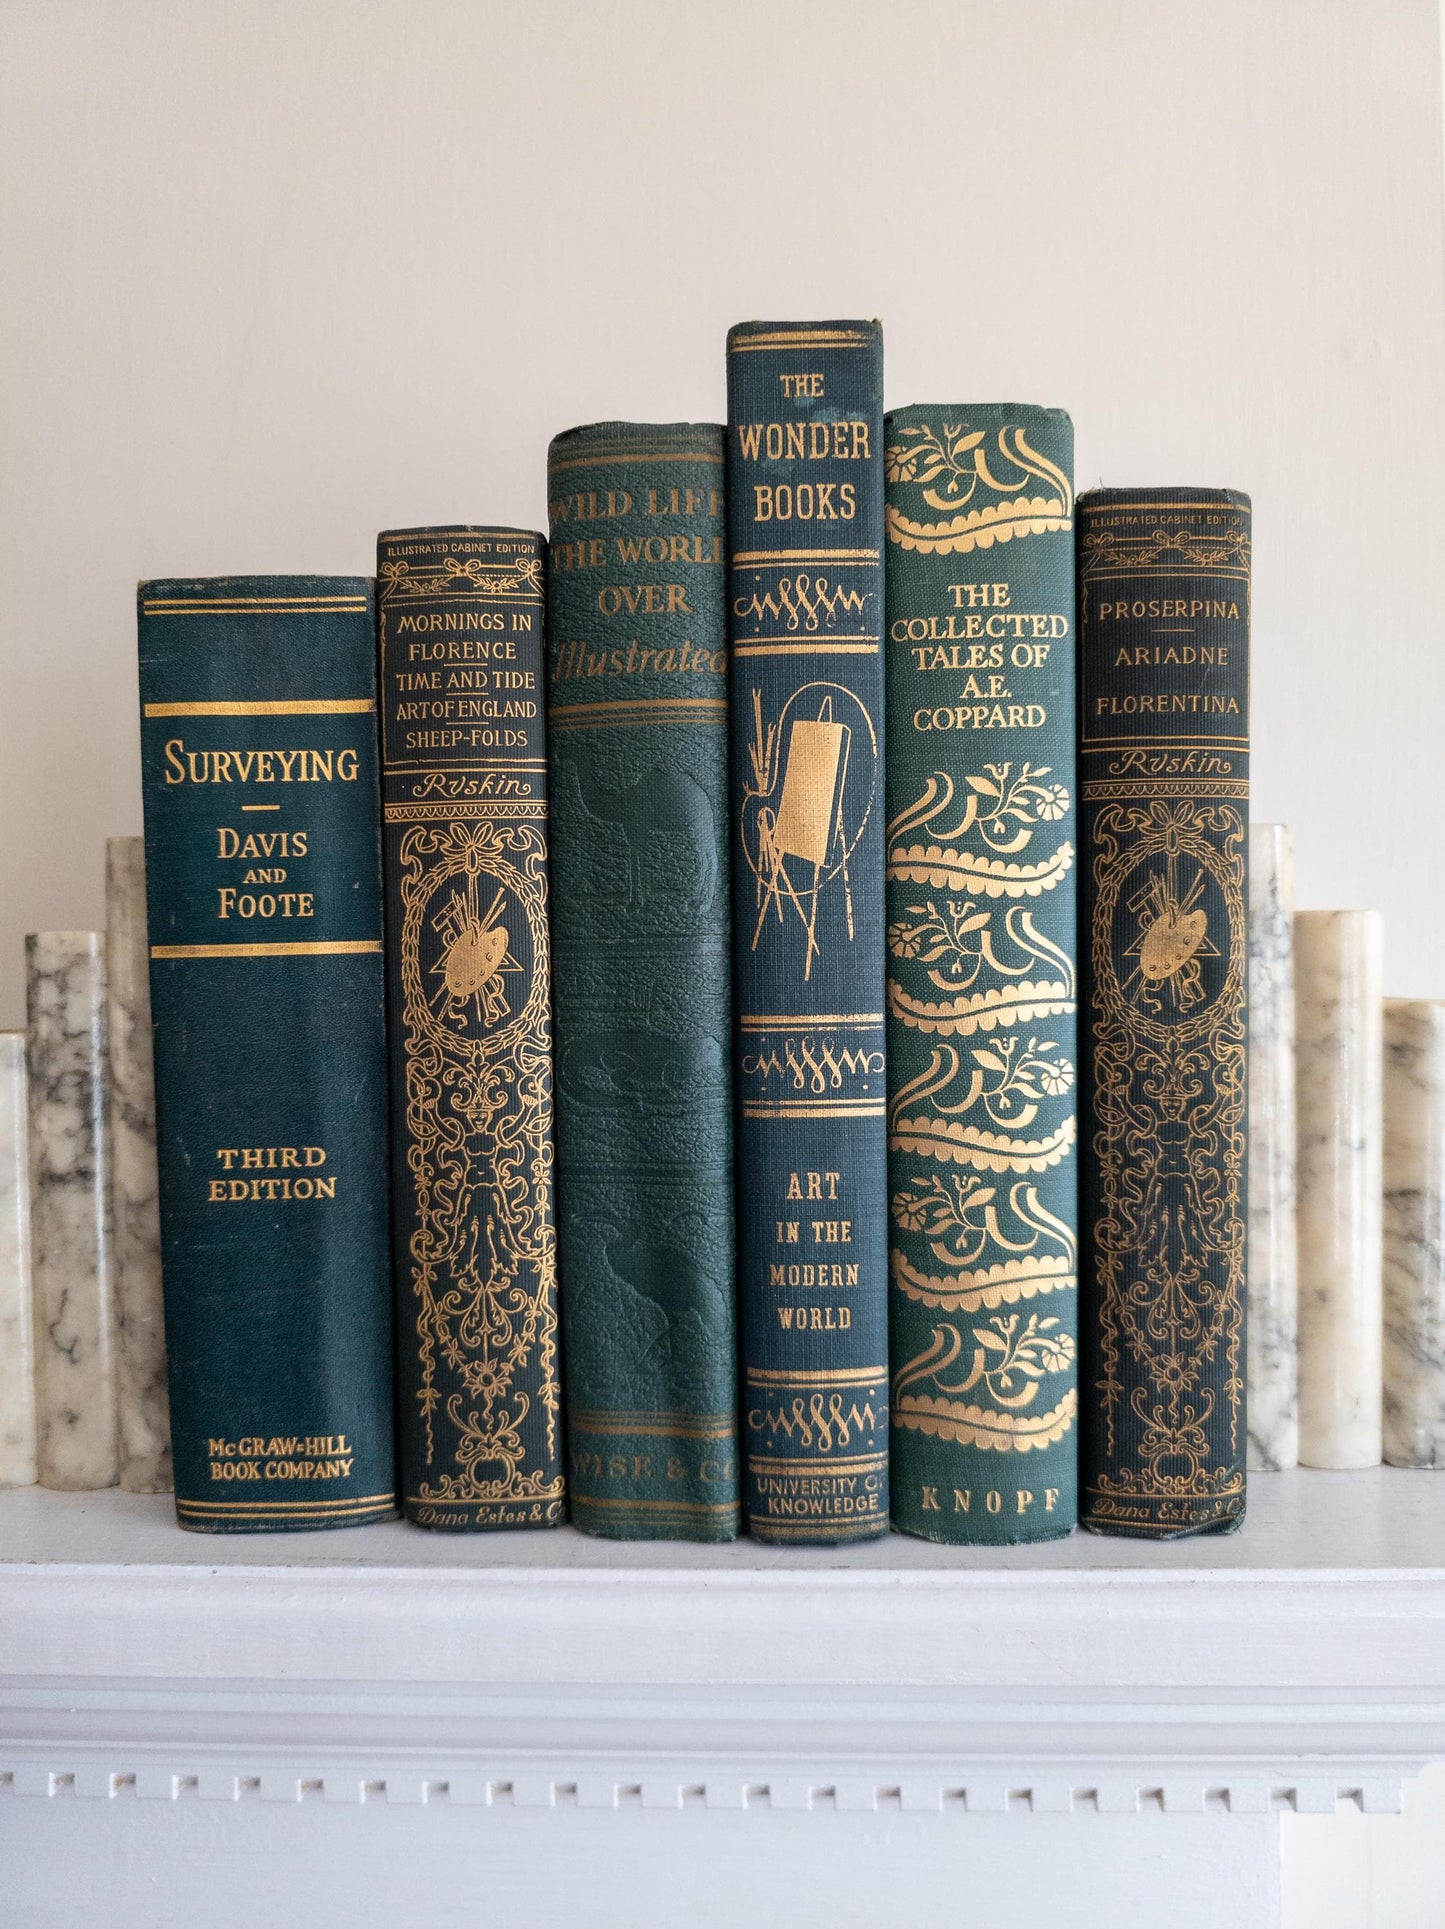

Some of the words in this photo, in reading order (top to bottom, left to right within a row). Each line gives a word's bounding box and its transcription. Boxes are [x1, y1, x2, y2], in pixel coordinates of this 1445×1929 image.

[779, 372, 825, 398] THE
[738, 420, 872, 461] WONDER
[753, 483, 856, 522] BOOKS
[386, 542, 449, 557] ILLUSTRATED
[450, 542, 493, 553] CABINET
[495, 543, 535, 554] EDITION
[554, 538, 607, 570] THE
[598, 583, 693, 615] OVER
[947, 583, 1011, 608] THE
[1100, 599, 1240, 620] PROSERPINA
[397, 612, 505, 634] MORNINGS
[512, 613, 532, 632] IN
[891, 613, 1070, 642] COLLECTED
[409, 640, 517, 661] FLORENCE
[911, 643, 1004, 671] TALES
[1010, 643, 1051, 668] OF
[1114, 645, 1229, 667] ARIADNE
[395, 671, 443, 692] TIME
[447, 670, 488, 689] AND
[492, 670, 535, 690] TIDE
[959, 673, 1013, 699] A.E.
[396, 701, 435, 721] ART
[432, 700, 455, 718] OF
[457, 699, 537, 718] ENGLAND
[1097, 693, 1241, 715] FLORENTINA
[913, 703, 1047, 731] COPPARD
[406, 729, 529, 749] SHEEP-FOLDS
[164, 739, 360, 784] SURVEYING
[216, 827, 308, 859] DAVIS
[242, 867, 287, 884] AND
[217, 887, 314, 919] FOOTE
[216, 1146, 327, 1170] THIRD
[208, 1176, 337, 1202] EDITION
[786, 1171, 841, 1200] ART
[776, 1221, 800, 1244] IN
[811, 1220, 852, 1243] THE
[770, 1263, 860, 1287] MODERN
[777, 1307, 852, 1330] WORLD
[210, 1461, 262, 1481] BOOK
[264, 1458, 355, 1480] COMPANY
[757, 1476, 858, 1496] UNIVERSITY
[768, 1491, 881, 1517] KNOWLEDGE
[922, 1486, 1060, 1515] KNOPF
[1090, 1496, 1152, 1520] Dana
[416, 1505, 470, 1526] Dana
[475, 1504, 527, 1524] Estes
[529, 1503, 543, 1521] &
